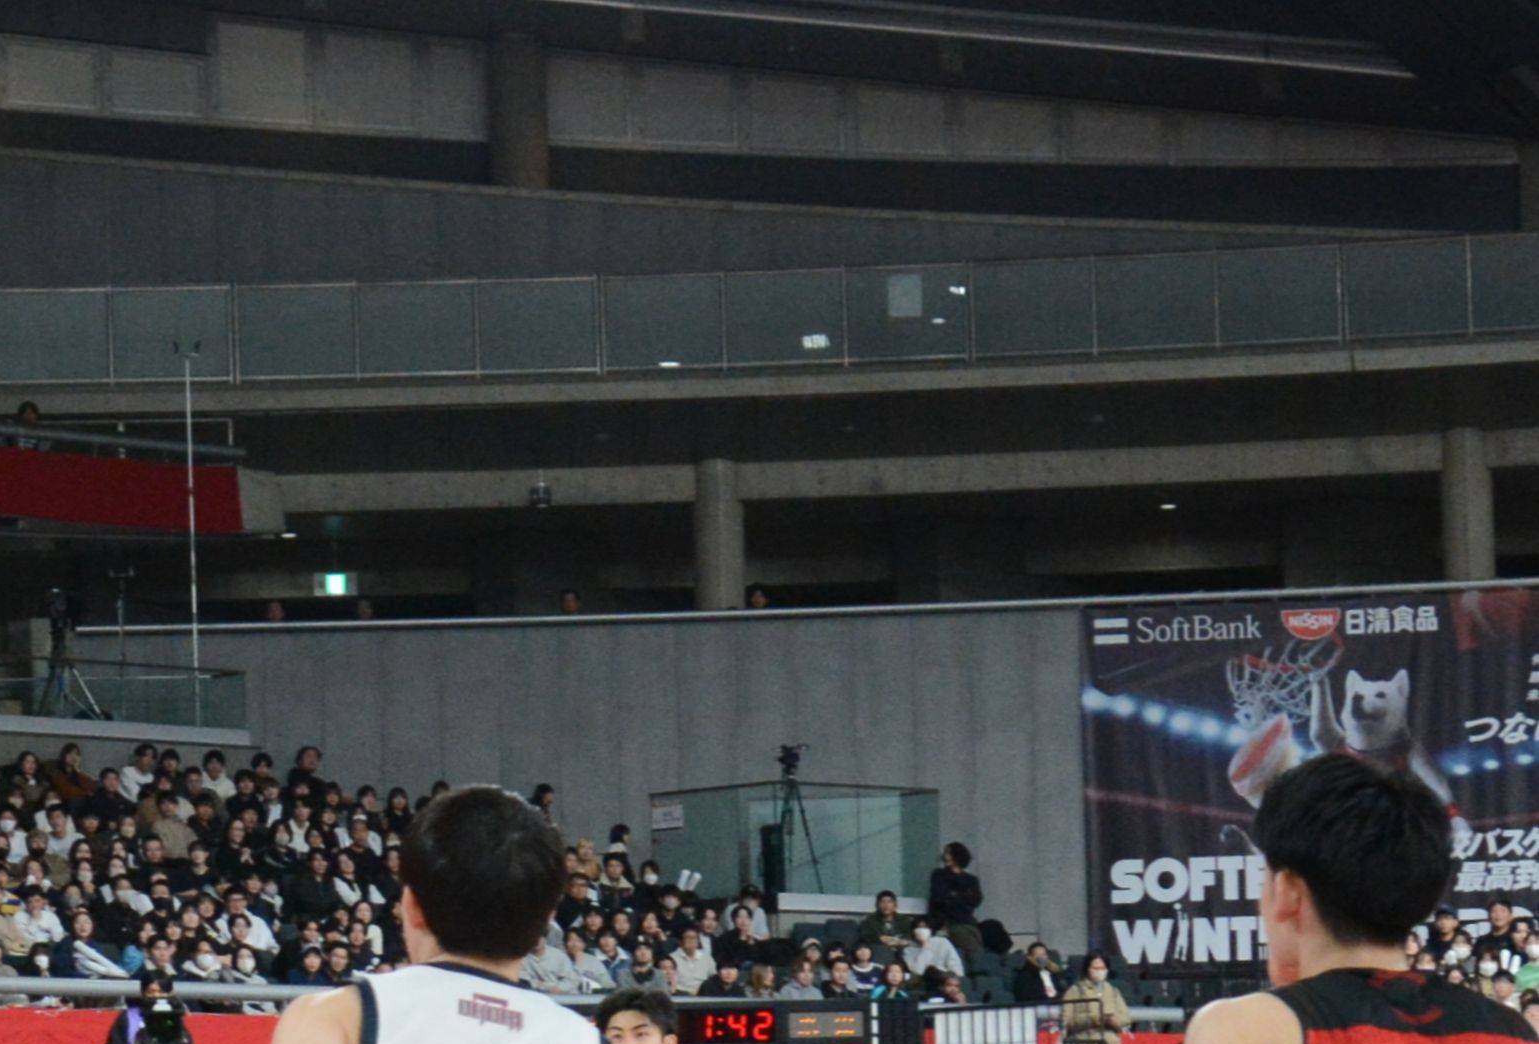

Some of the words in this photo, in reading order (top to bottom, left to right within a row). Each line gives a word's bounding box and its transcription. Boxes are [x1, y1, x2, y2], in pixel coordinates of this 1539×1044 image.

[1136, 614, 1262, 643] SoftBank
[1345, 606, 1439, 635] 日清食品
[1464, 712, 1539, 743] つな
[705, 1010, 774, 1041] 1:42
